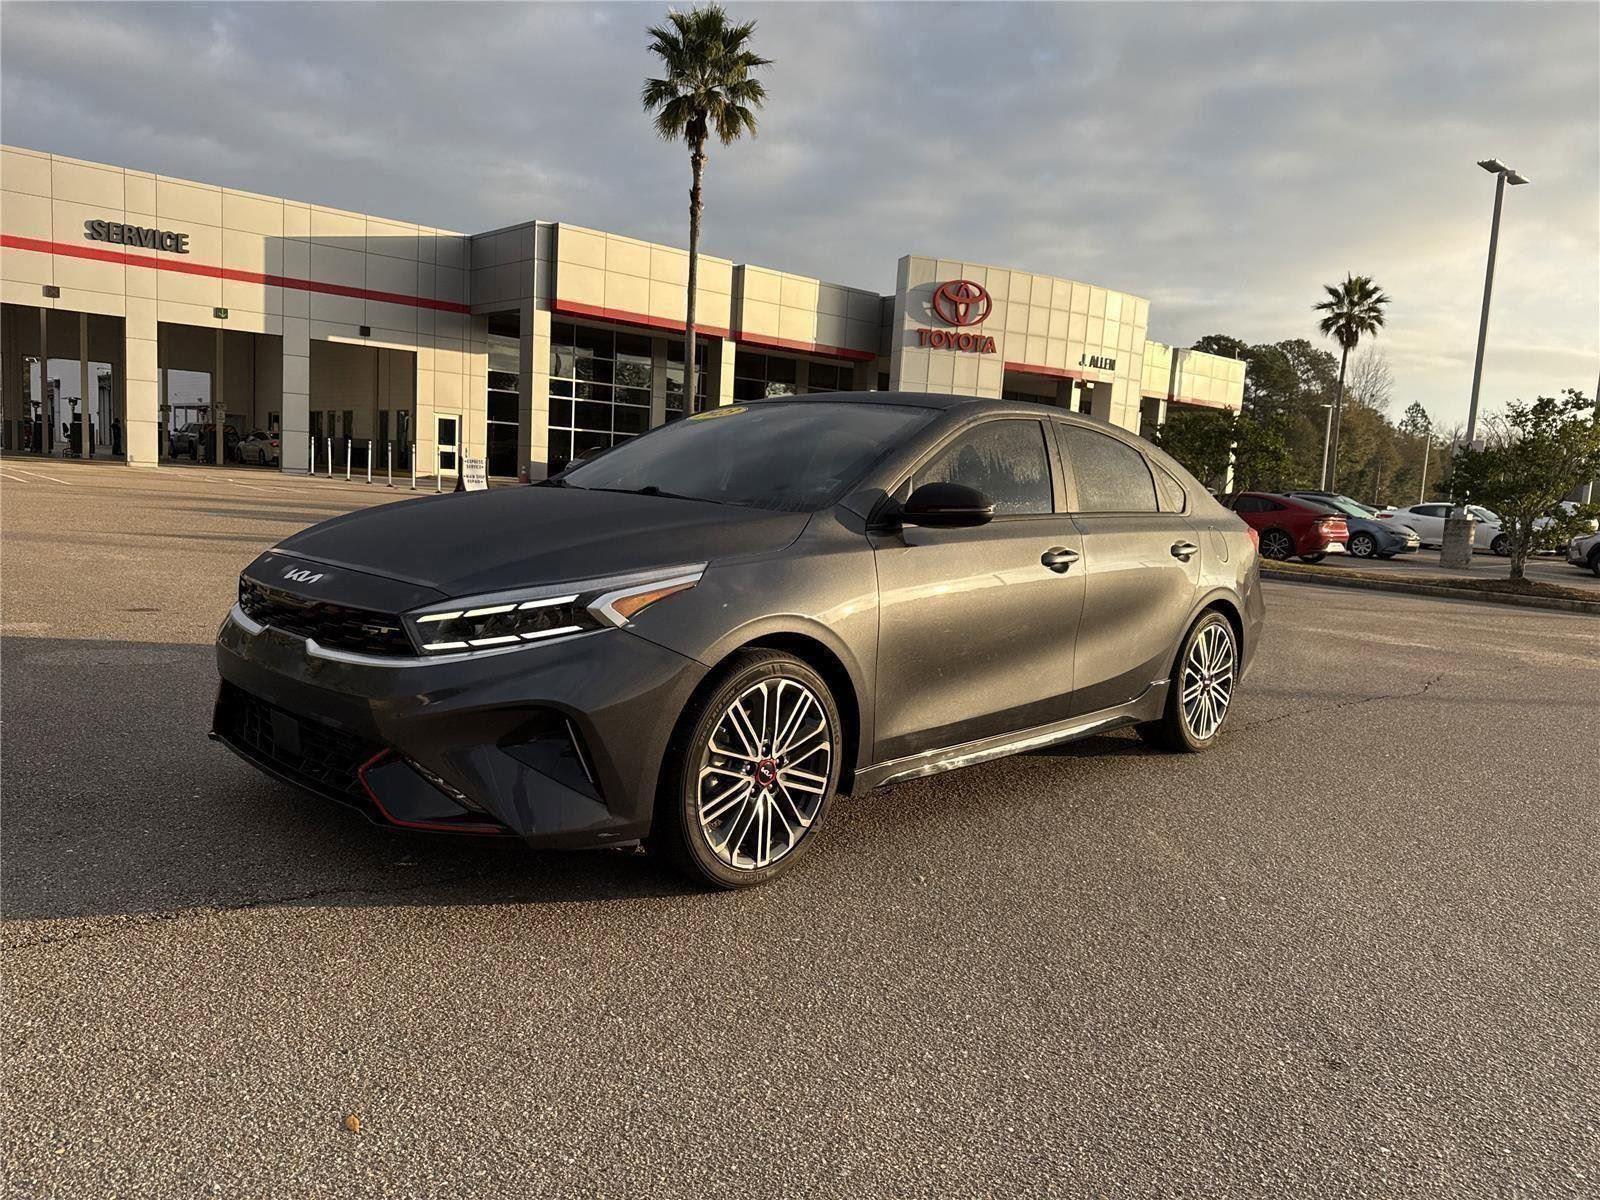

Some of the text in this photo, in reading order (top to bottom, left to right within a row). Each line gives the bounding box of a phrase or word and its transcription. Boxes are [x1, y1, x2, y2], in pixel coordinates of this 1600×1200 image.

[84, 219, 190, 254] SERVICE
[917, 328, 997, 354] TOYOTA
[1078, 353, 1116, 371] J. ALLEN
